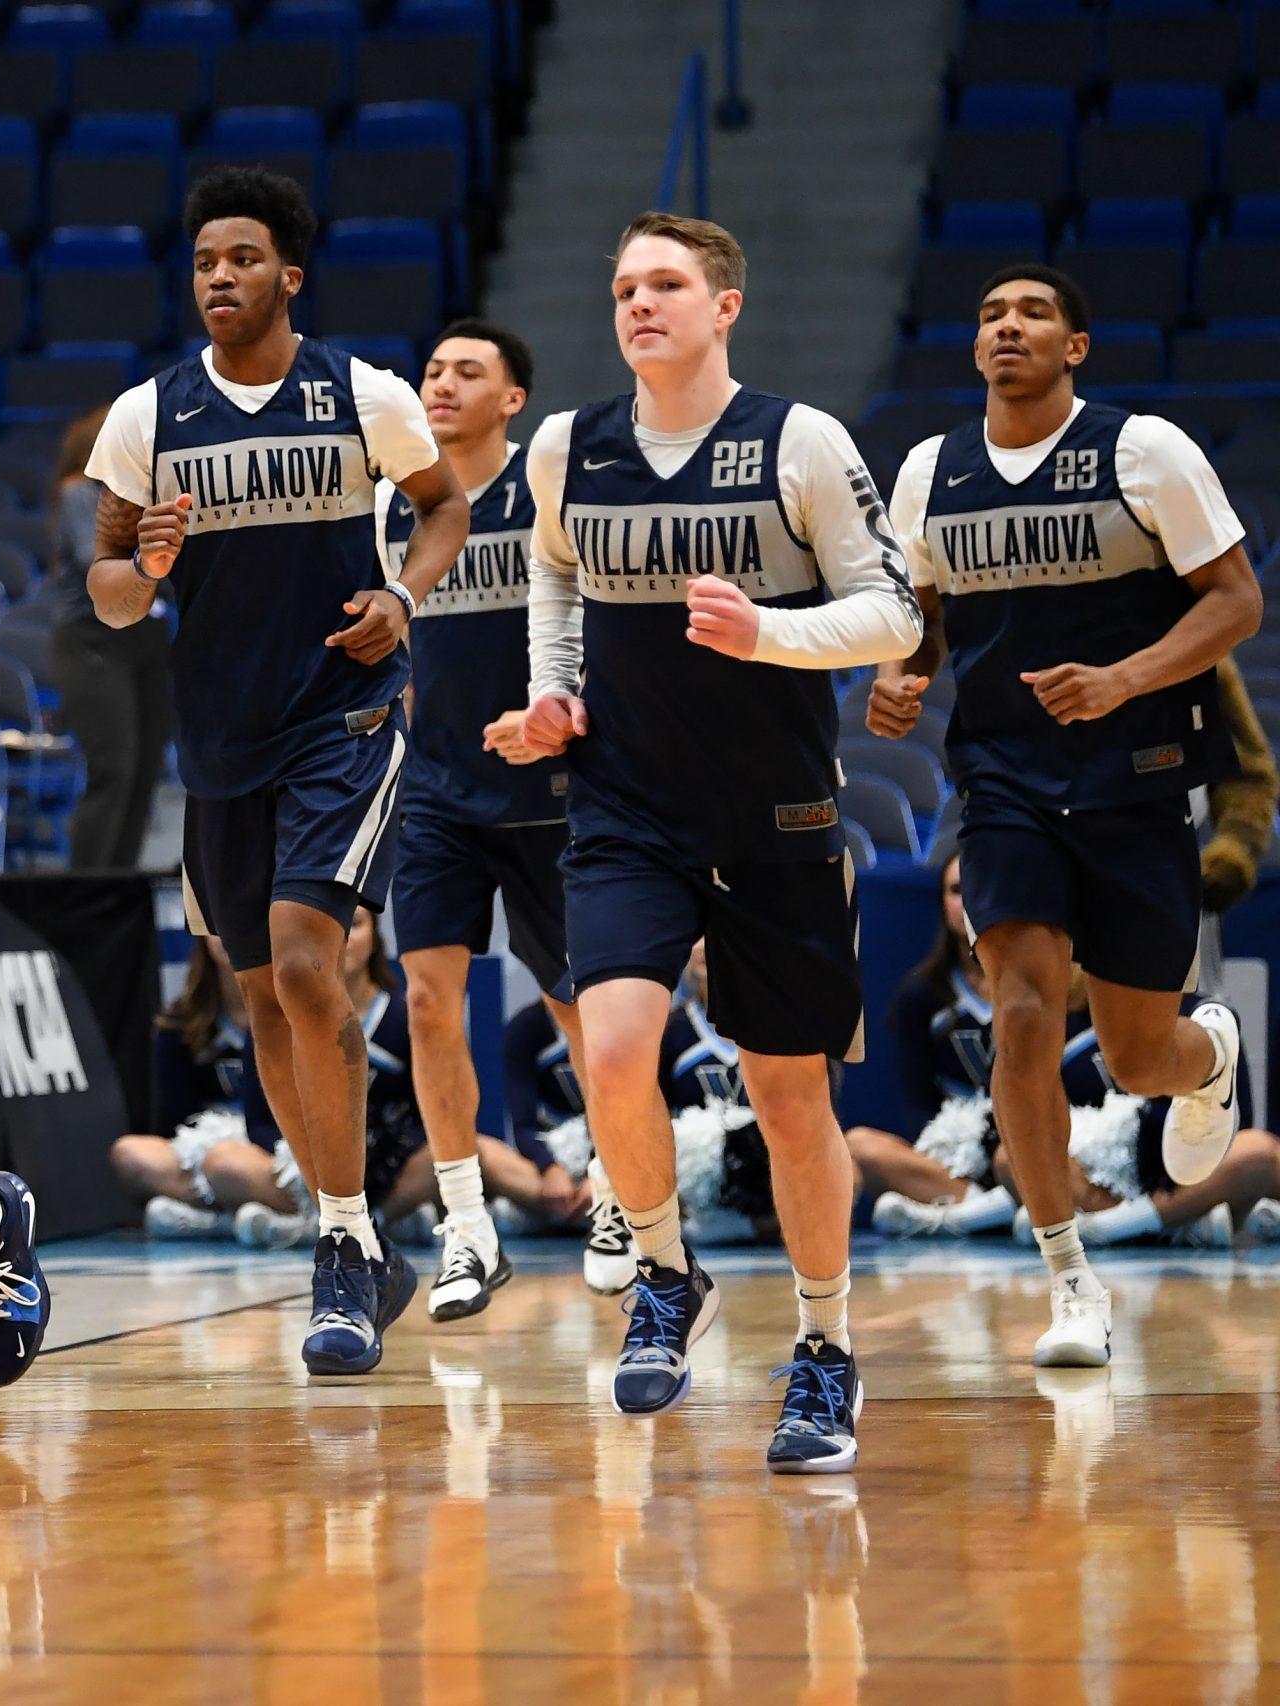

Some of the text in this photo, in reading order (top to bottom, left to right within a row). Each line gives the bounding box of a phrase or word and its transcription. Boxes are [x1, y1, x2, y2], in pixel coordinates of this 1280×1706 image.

[299, 380, 336, 422] 15
[172, 446, 343, 510] VILLANOVA
[711, 439, 764, 488] 22
[1054, 449, 1099, 492] 23
[503, 481, 517, 519] 1
[573, 515, 764, 575] VILLANOVA
[941, 513, 1102, 572] VILLANOVA
